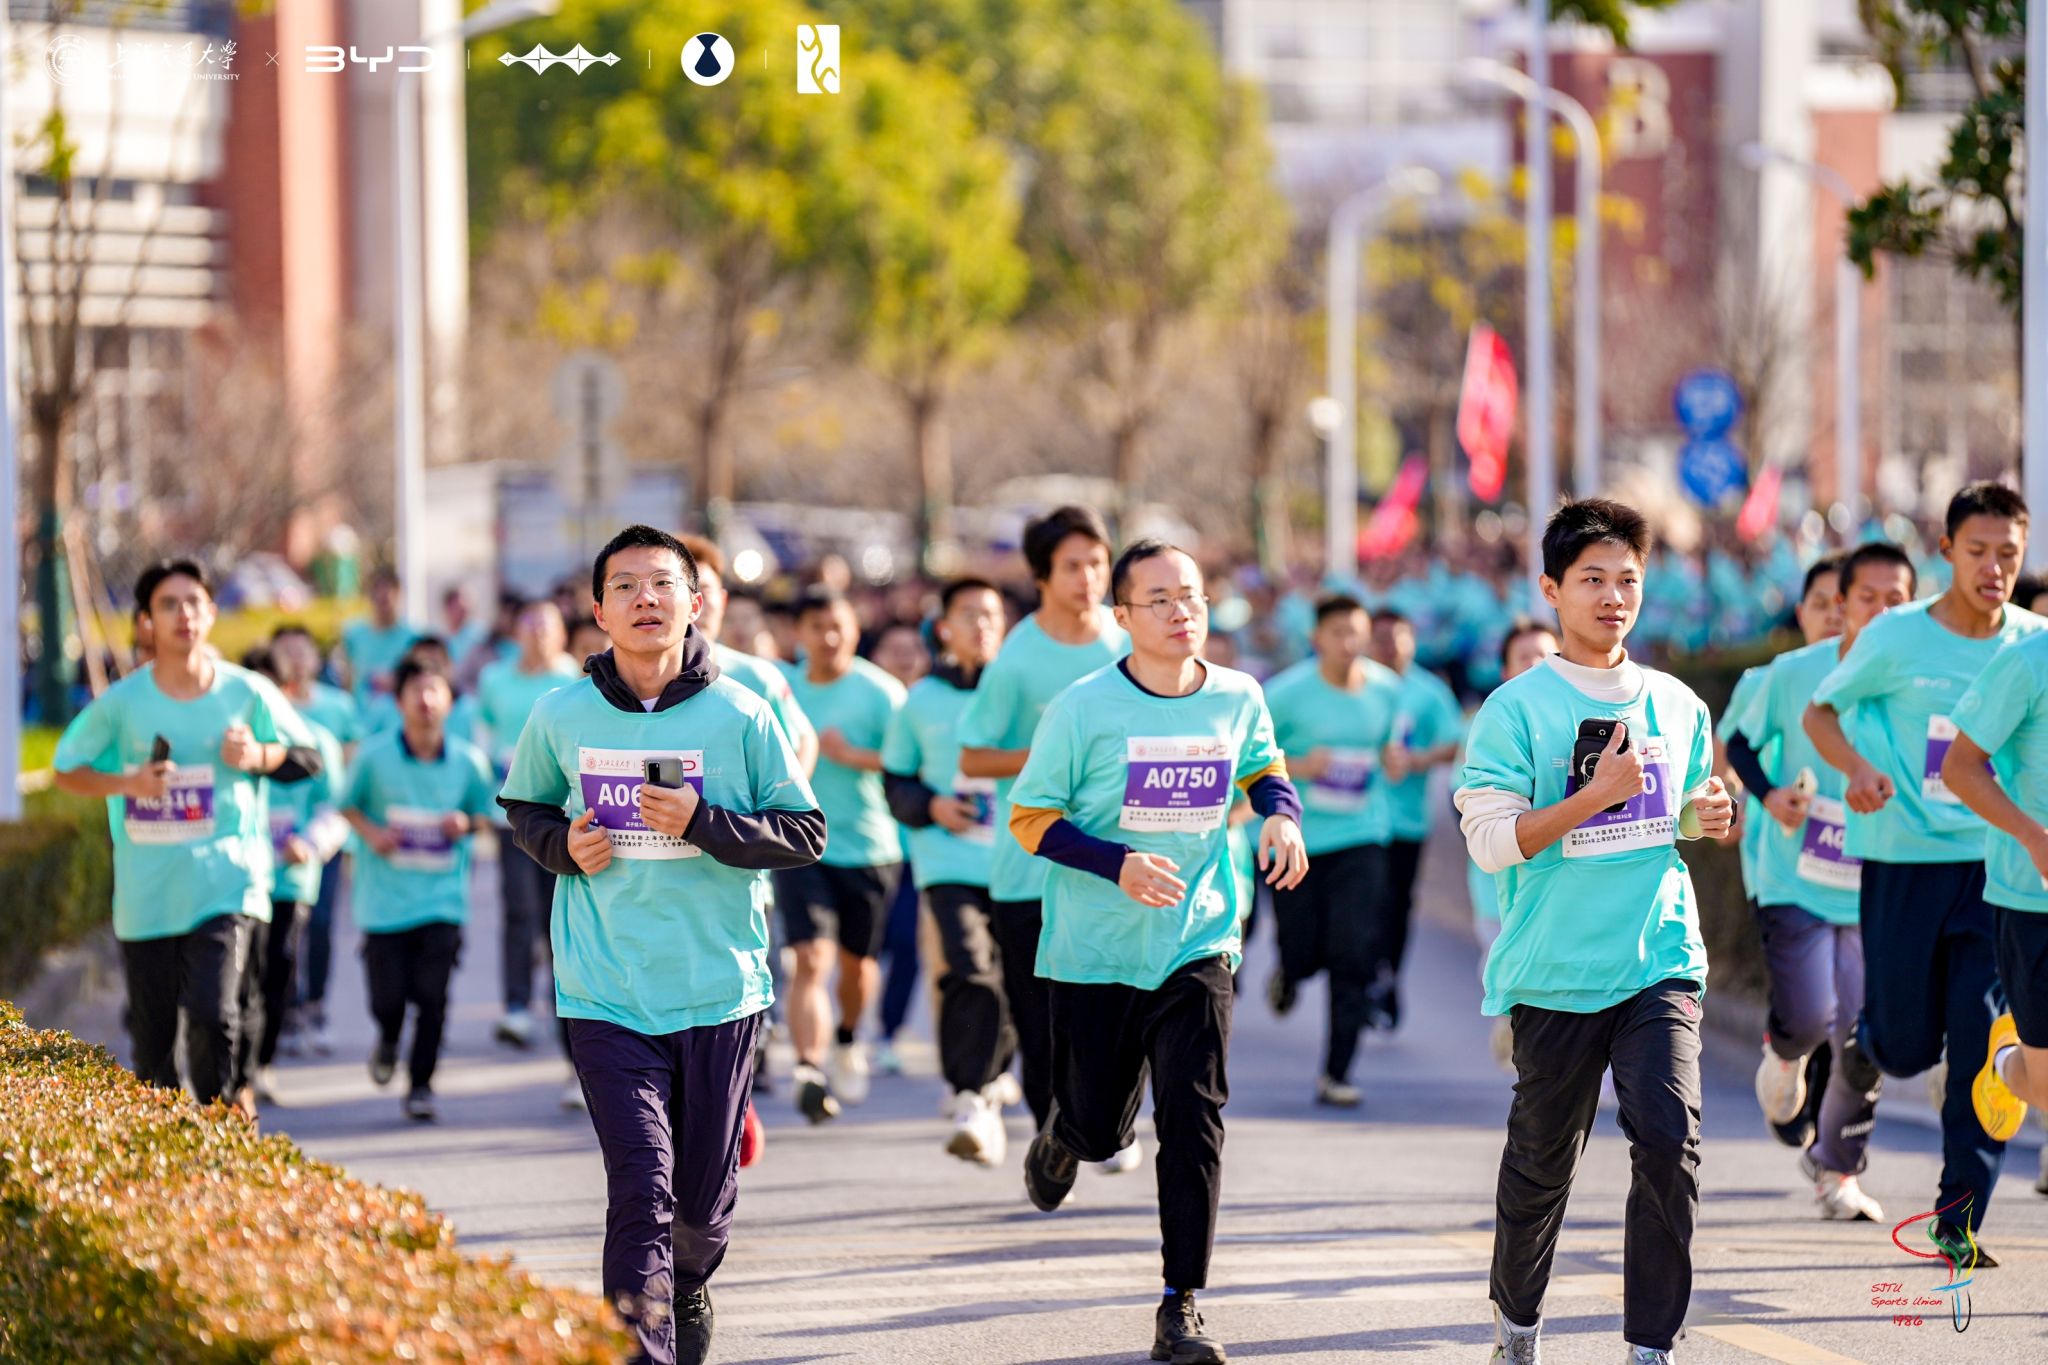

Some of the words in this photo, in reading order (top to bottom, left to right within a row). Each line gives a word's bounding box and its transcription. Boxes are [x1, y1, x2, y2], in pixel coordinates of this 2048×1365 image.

[1606, 58, 1674, 159] B
[1186, 744, 1228, 756] BYD
[1143, 766, 1217, 789] A0750
[597, 783, 641, 808] A06
